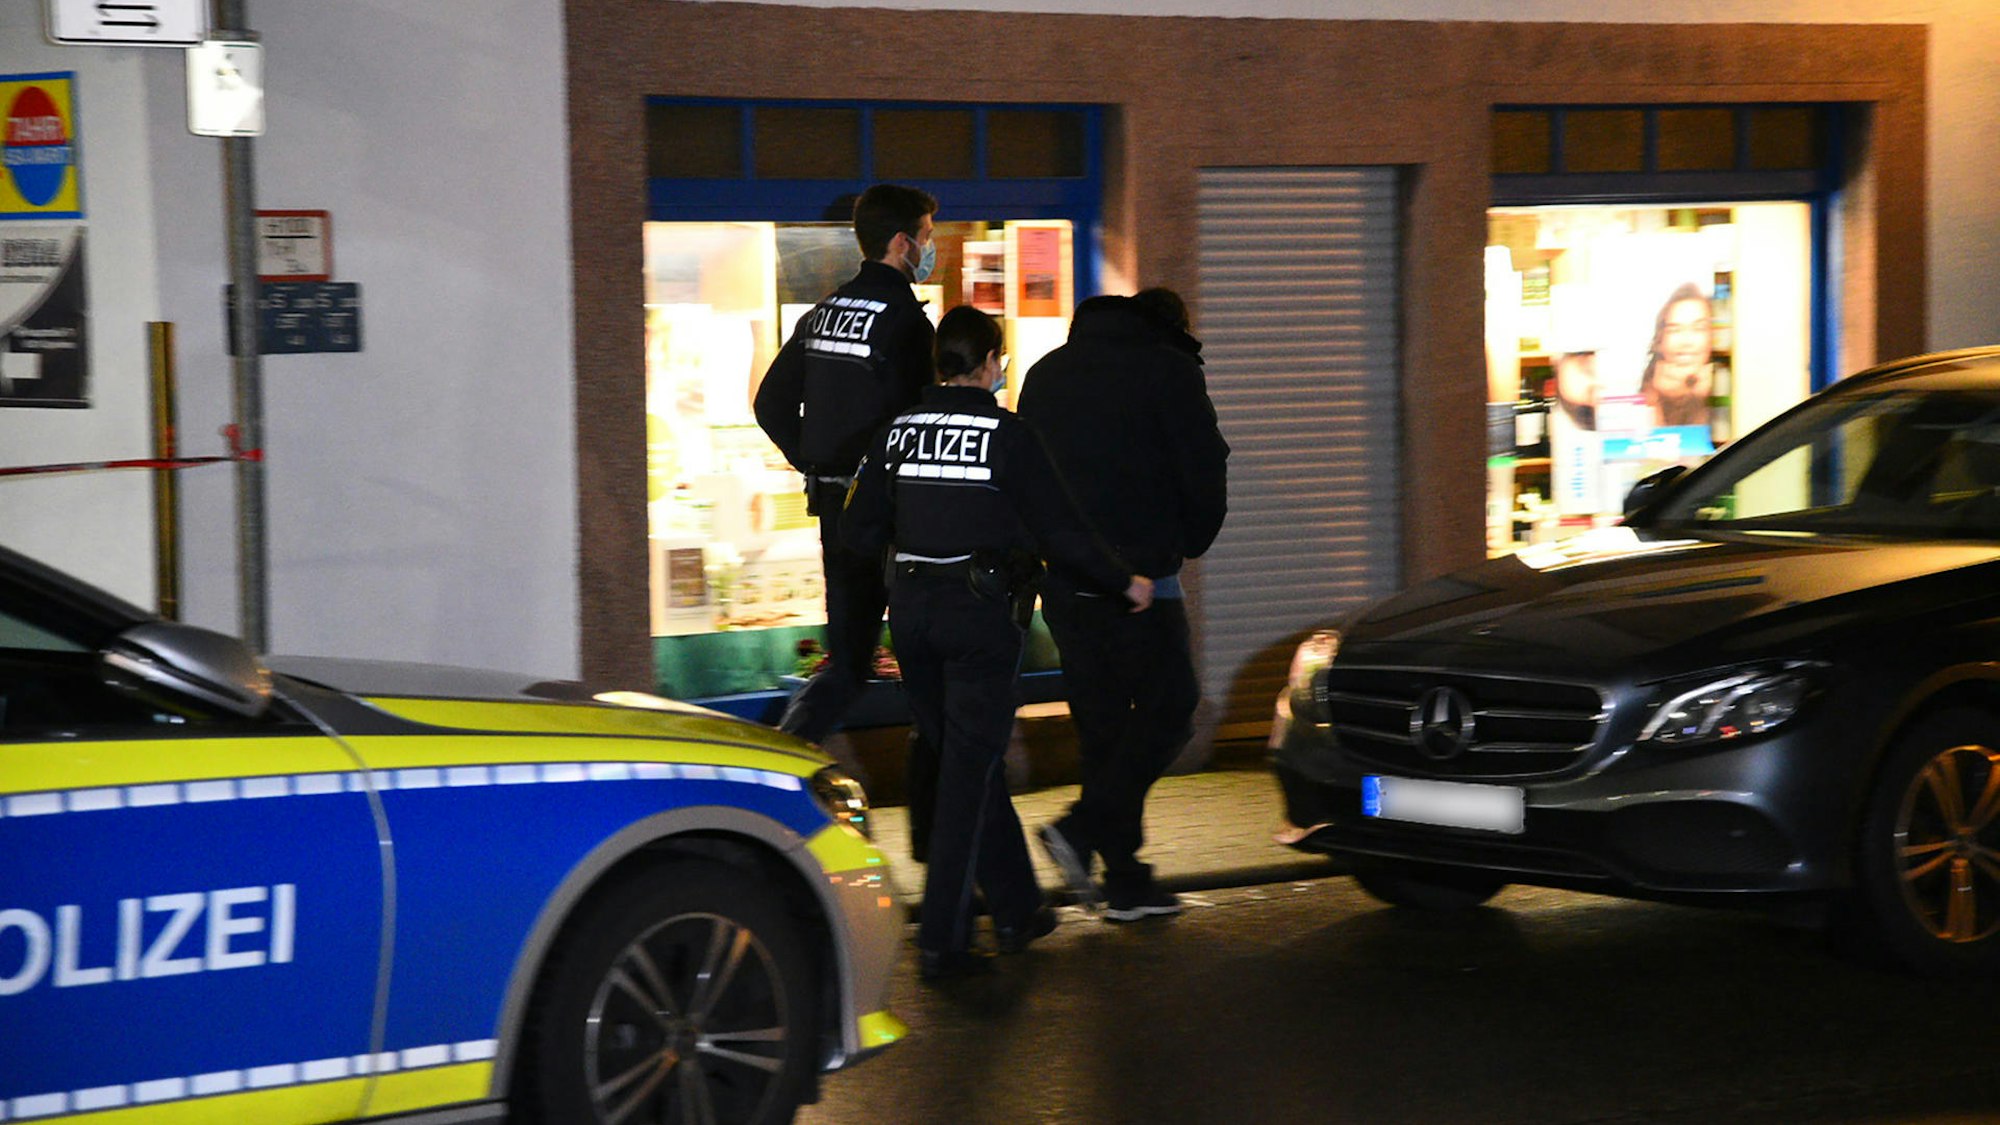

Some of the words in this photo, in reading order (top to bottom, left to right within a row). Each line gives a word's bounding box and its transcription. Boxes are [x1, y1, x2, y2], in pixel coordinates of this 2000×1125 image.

[805, 306, 875, 341] POLIZEI
[885, 427, 990, 463] POLIZEI
[0, 883, 297, 996] OLIZEI
